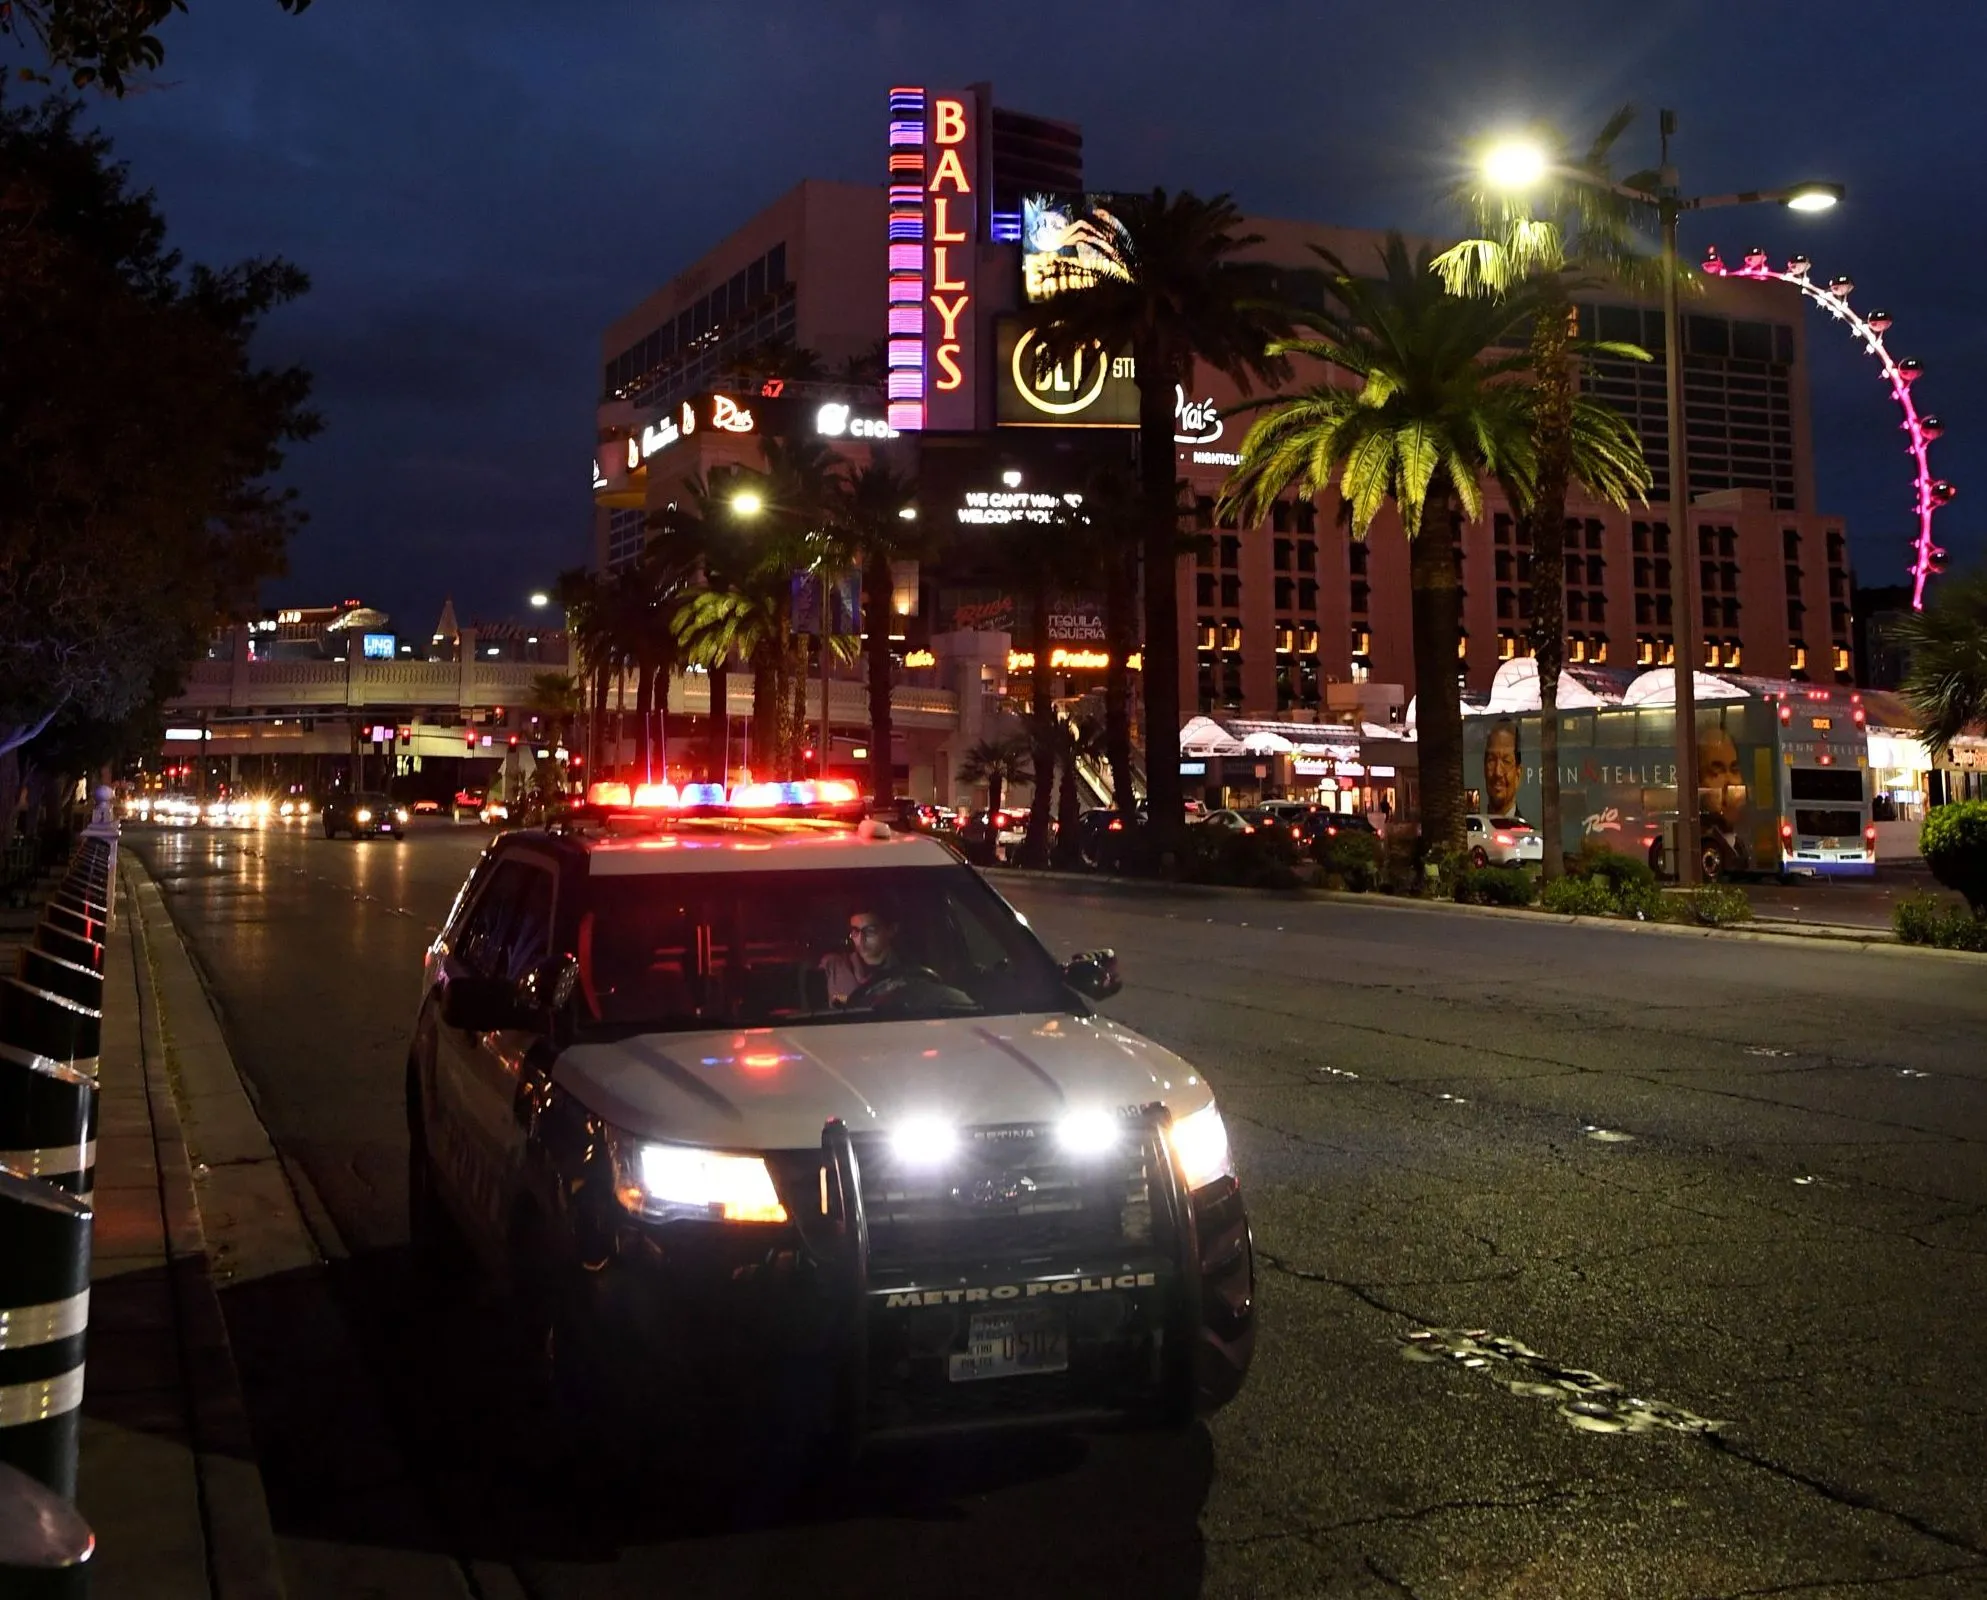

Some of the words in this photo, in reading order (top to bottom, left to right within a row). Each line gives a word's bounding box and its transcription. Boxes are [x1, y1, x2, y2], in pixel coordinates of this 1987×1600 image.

[929, 100, 970, 390] BALLYS
[1601, 764, 1677, 785] TELLER
[886, 1285, 1020, 1308] METRO
[1026, 1273, 1156, 1297] POLICE
